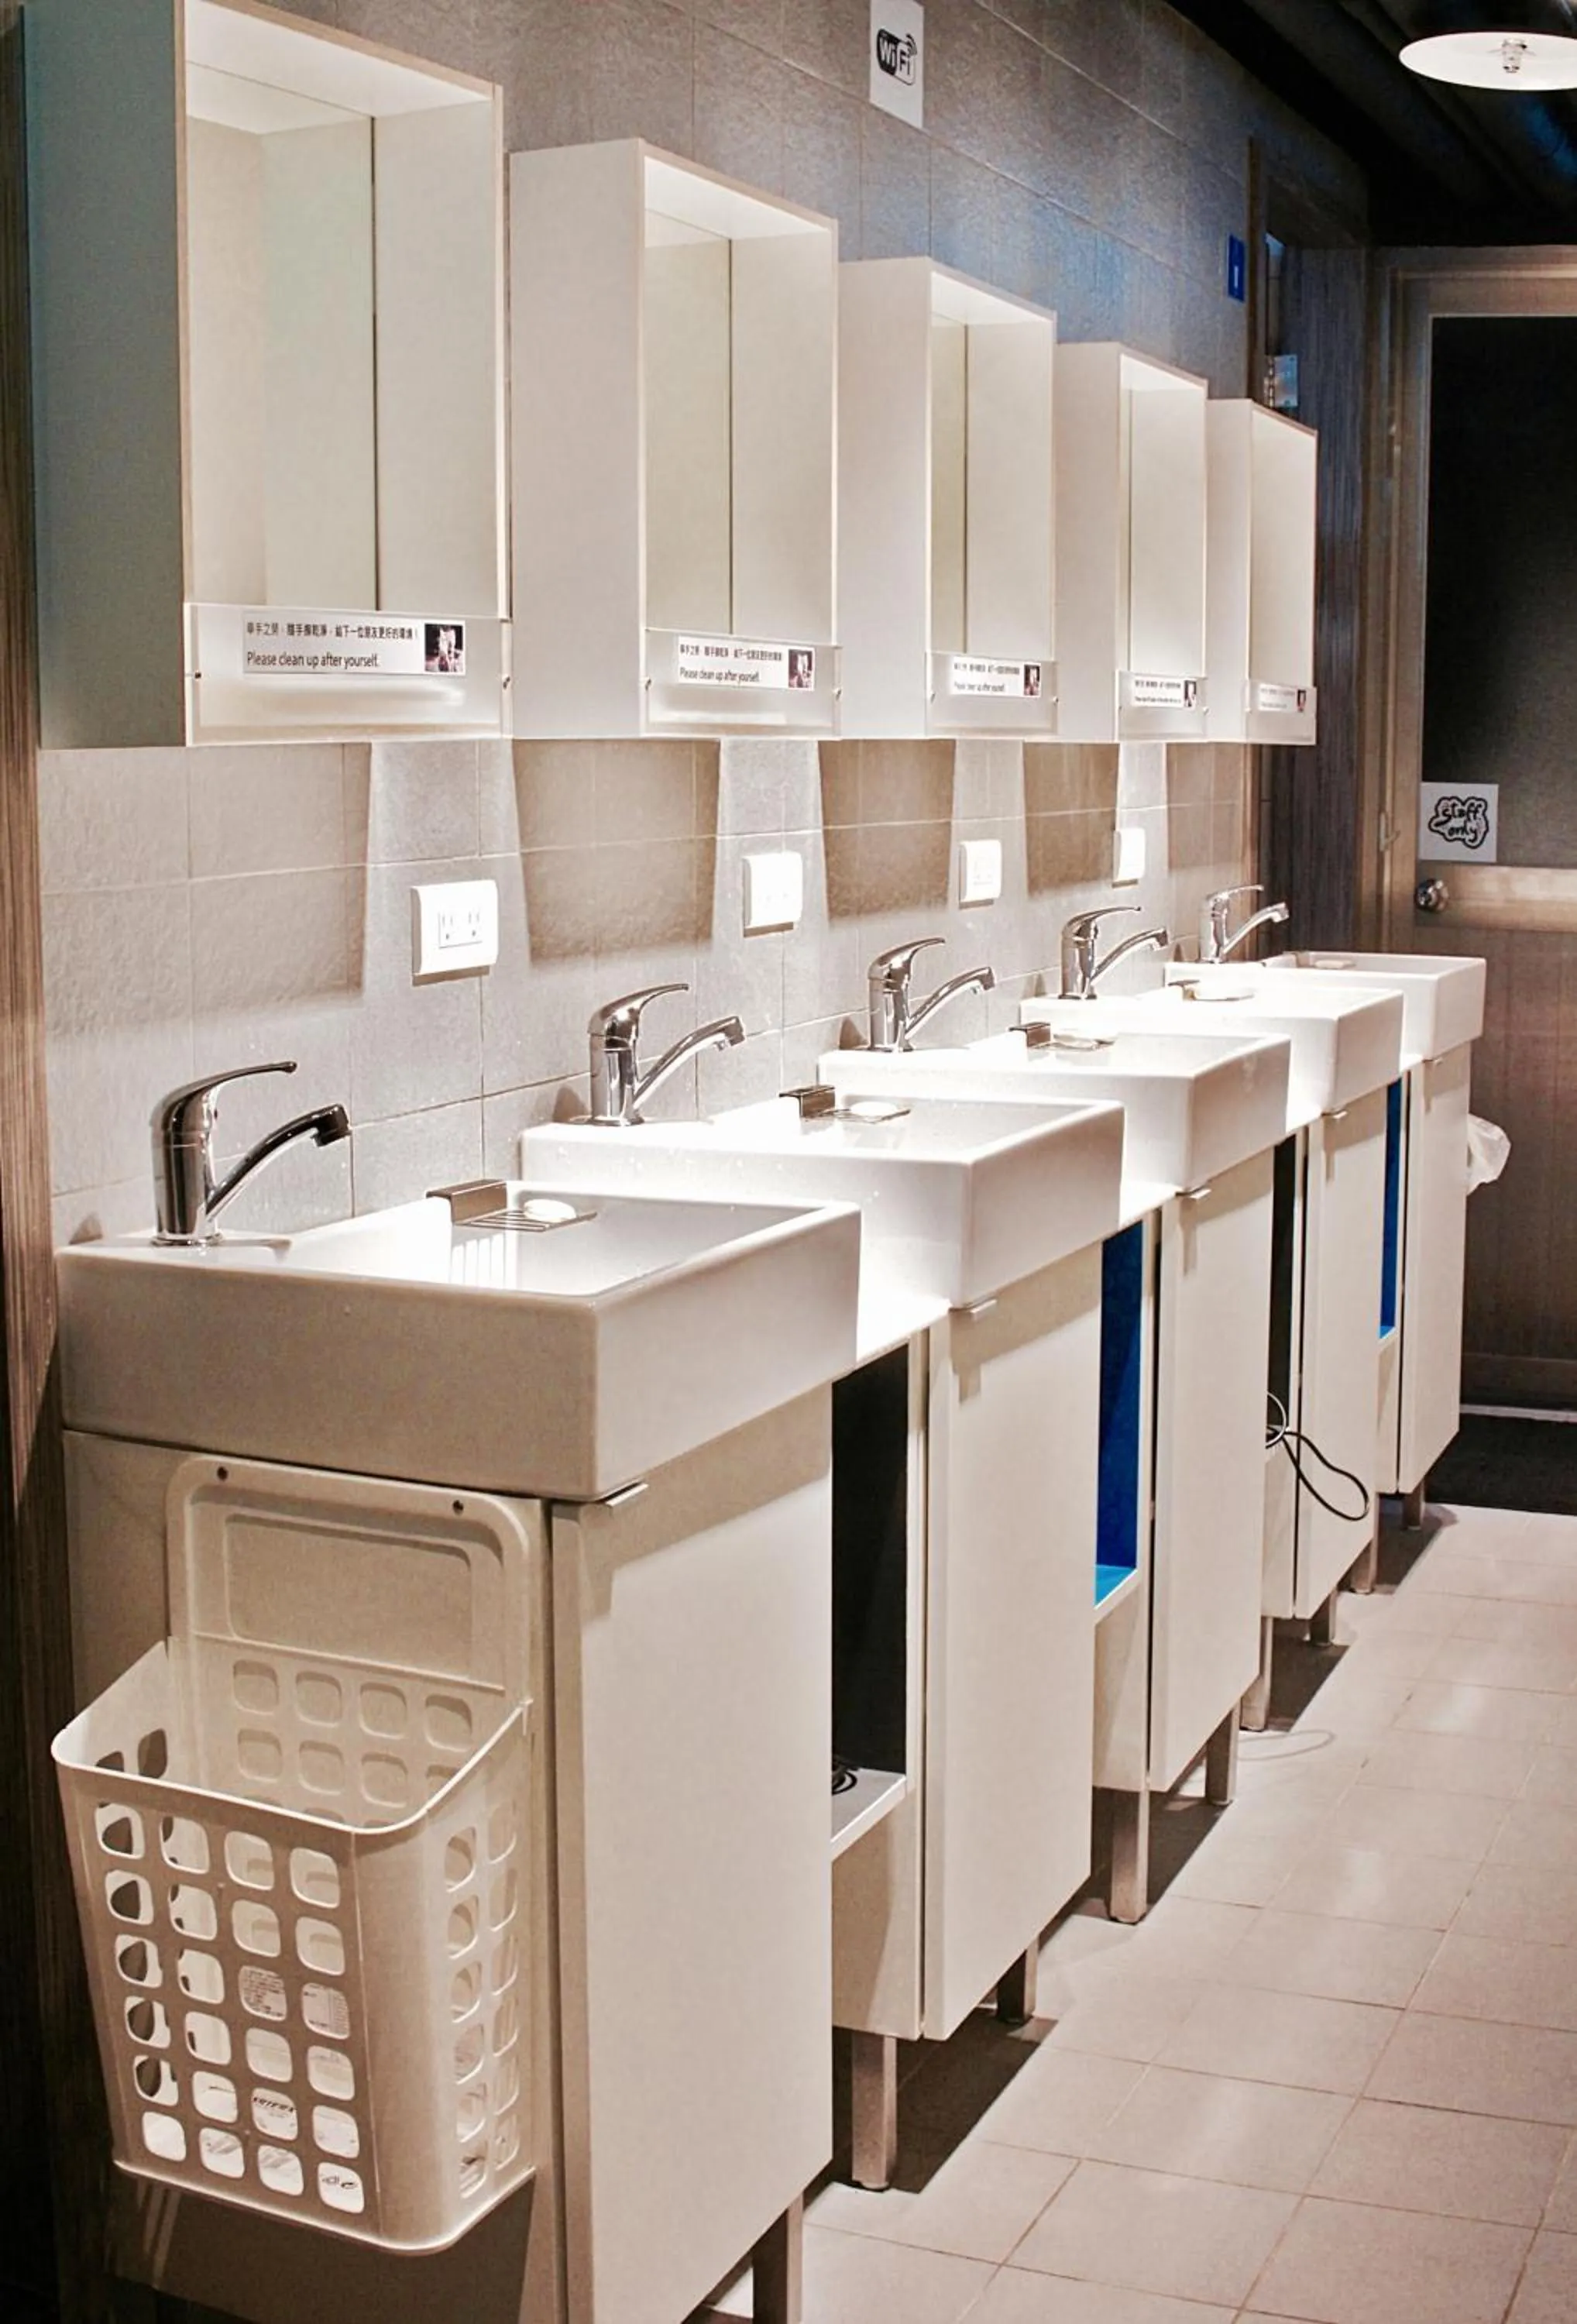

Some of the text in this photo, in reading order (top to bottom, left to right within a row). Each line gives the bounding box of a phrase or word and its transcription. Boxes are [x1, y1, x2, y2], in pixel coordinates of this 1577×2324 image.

[247, 651, 380, 669] Please clean up after yourself.
